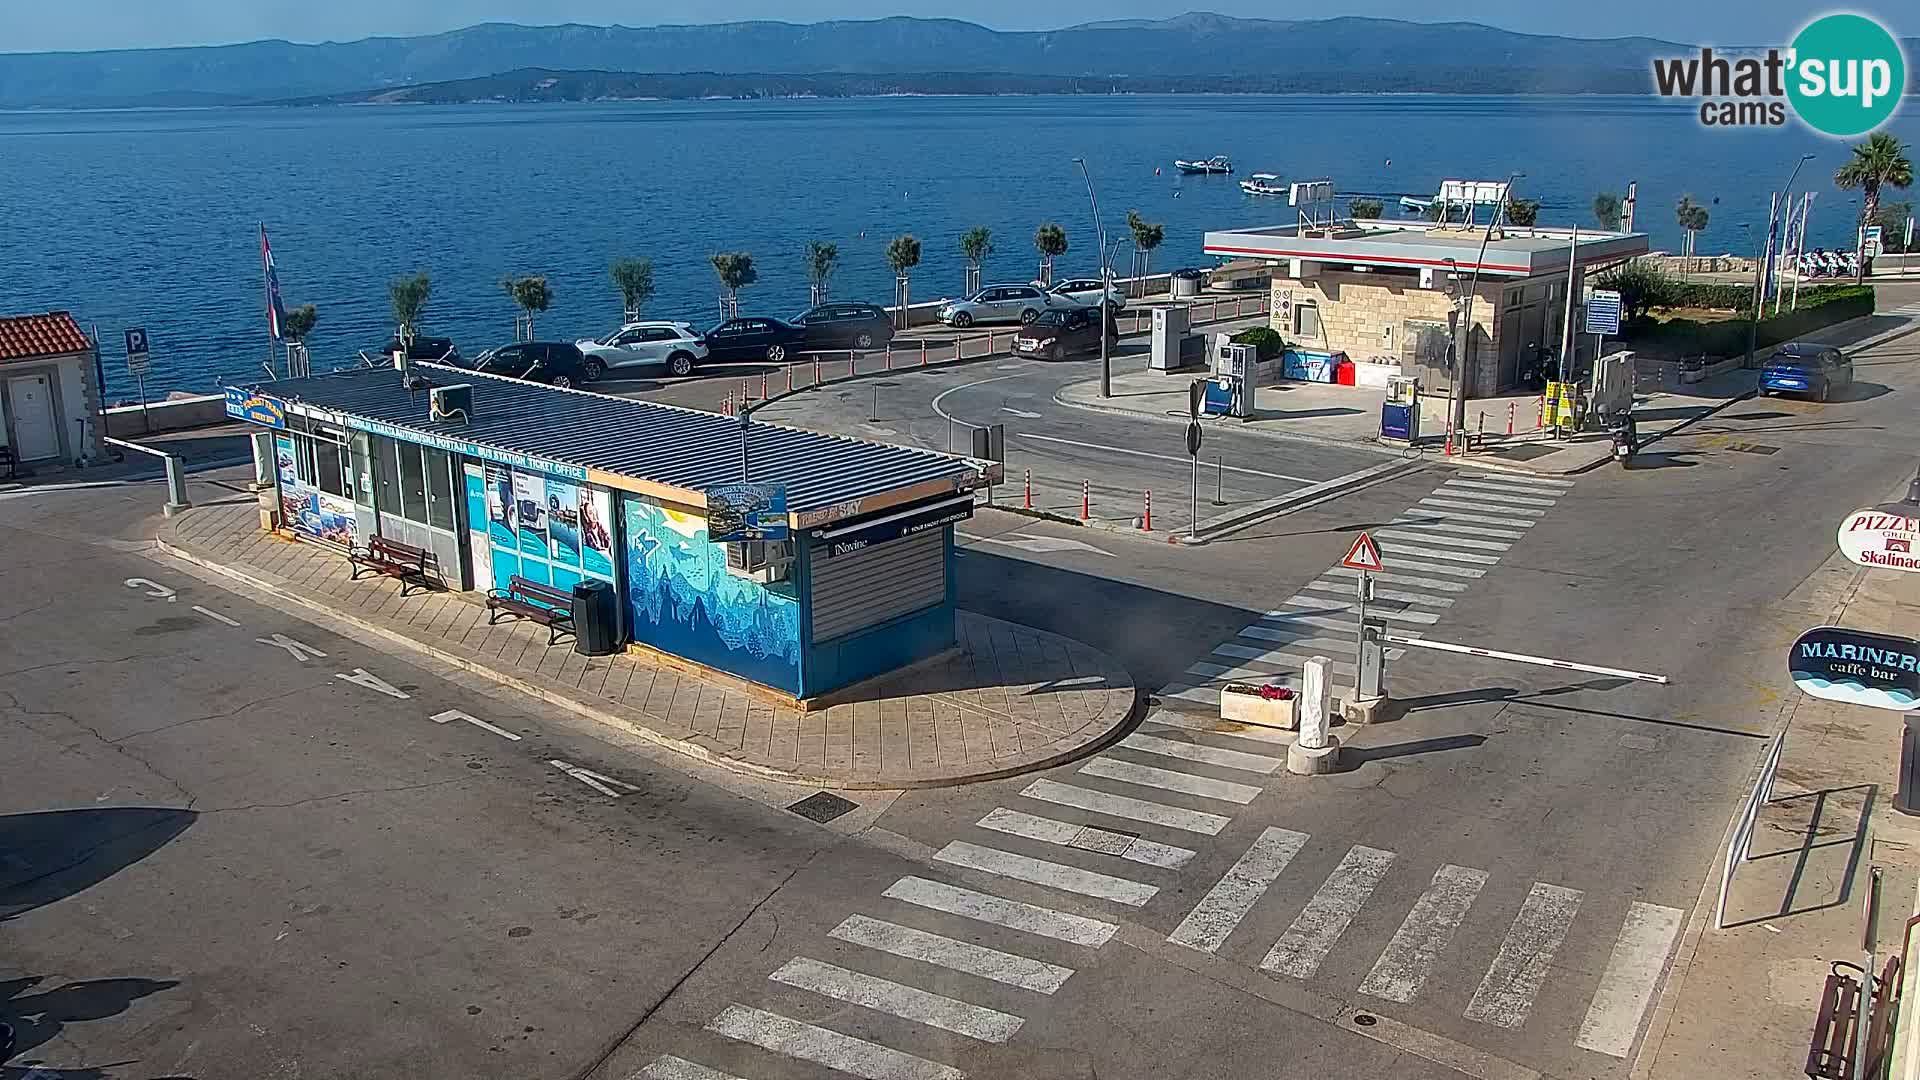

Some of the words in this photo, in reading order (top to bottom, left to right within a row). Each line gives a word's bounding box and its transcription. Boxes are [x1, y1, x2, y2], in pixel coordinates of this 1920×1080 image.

[435, 437, 468, 452] POSTAJA
[478, 447, 492, 458] BUS
[494, 451, 526, 465] STATION
[528, 459, 554, 472] TICKET
[555, 465, 583, 478] OFFICE
[1882, 530, 1918, 541] GRILL
[1829, 663, 1866, 676] caffe
[1870, 666, 1898, 681] bar
